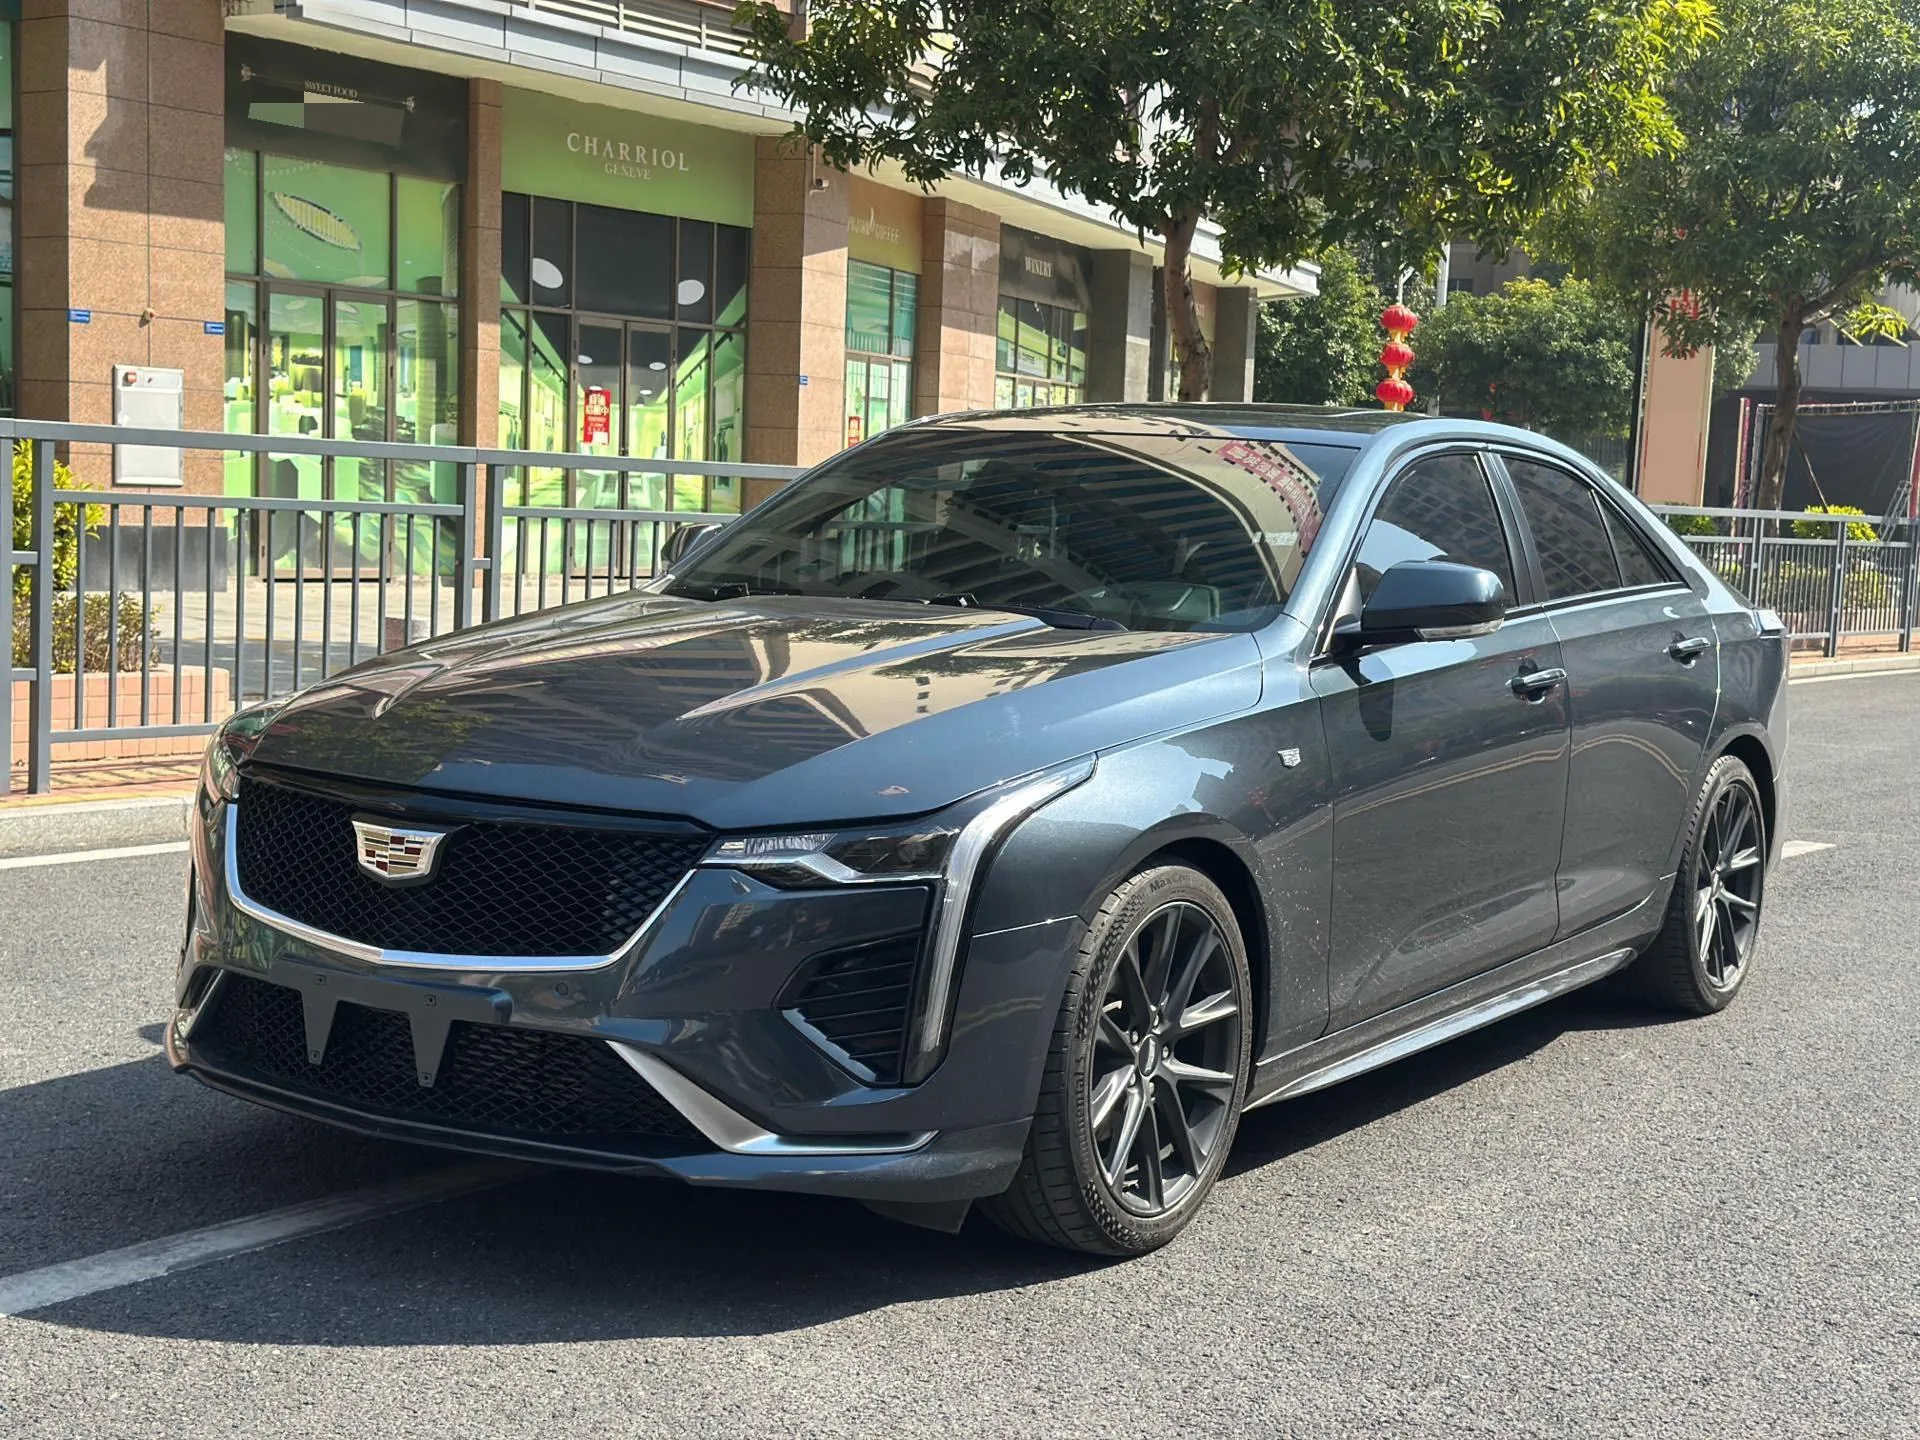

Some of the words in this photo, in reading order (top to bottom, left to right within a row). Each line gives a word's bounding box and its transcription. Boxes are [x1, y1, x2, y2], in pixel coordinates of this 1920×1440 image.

[304, 79, 331, 94] SWEET
[333, 85, 358, 98] FOOD
[567, 131, 689, 171] CHARRIOL
